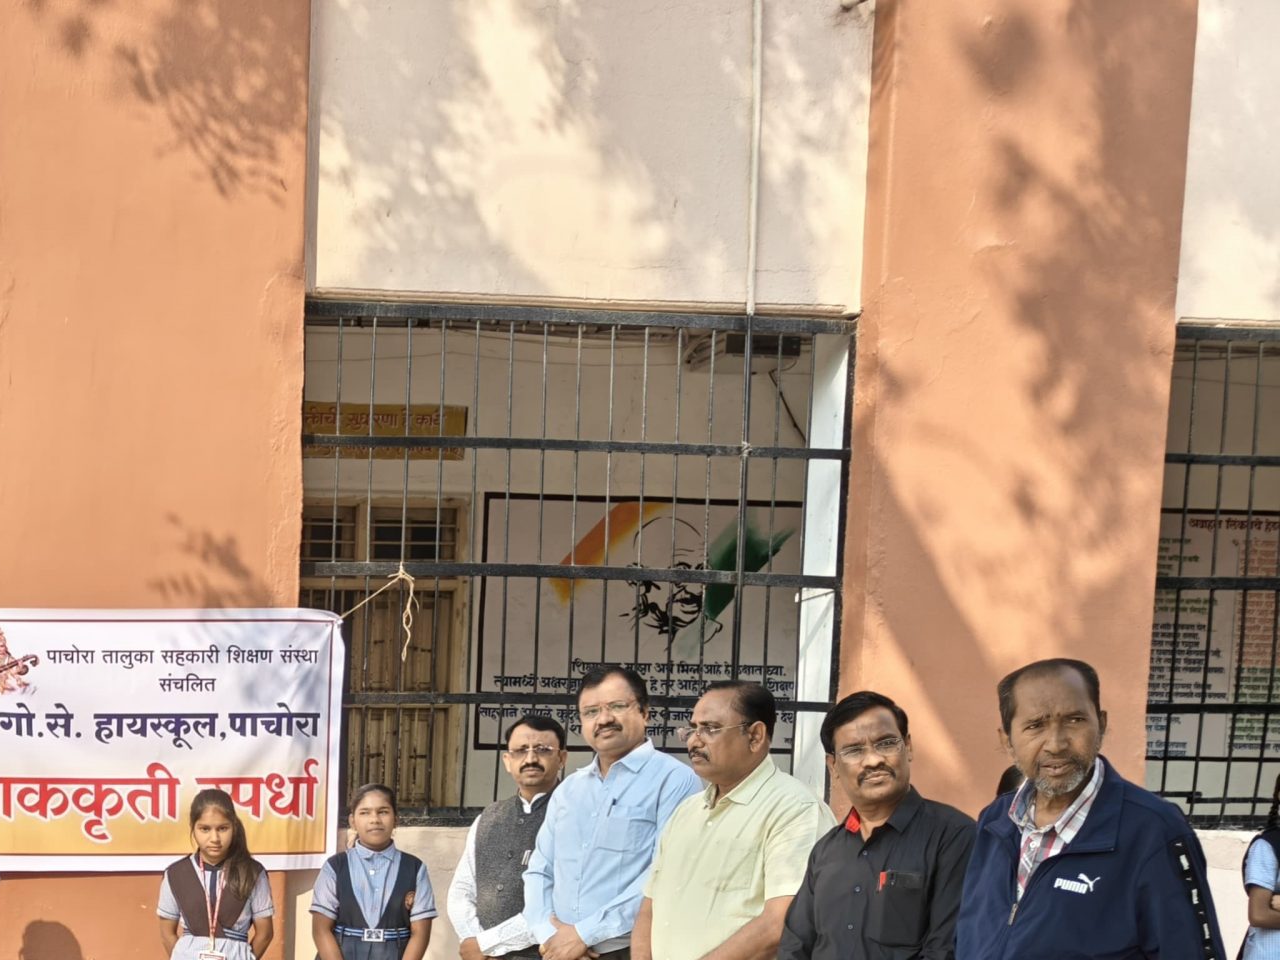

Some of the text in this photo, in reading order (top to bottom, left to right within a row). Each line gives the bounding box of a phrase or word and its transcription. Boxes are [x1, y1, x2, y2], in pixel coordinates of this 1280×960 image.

[47, 644, 319, 669] पाचोरा तालुका सहकारी शिक्षण संस्था
[159, 675, 216, 694] संचलित
[541, 676, 584, 692] अक्षरज्ञा
[1053, 877, 1089, 894] PUMA
